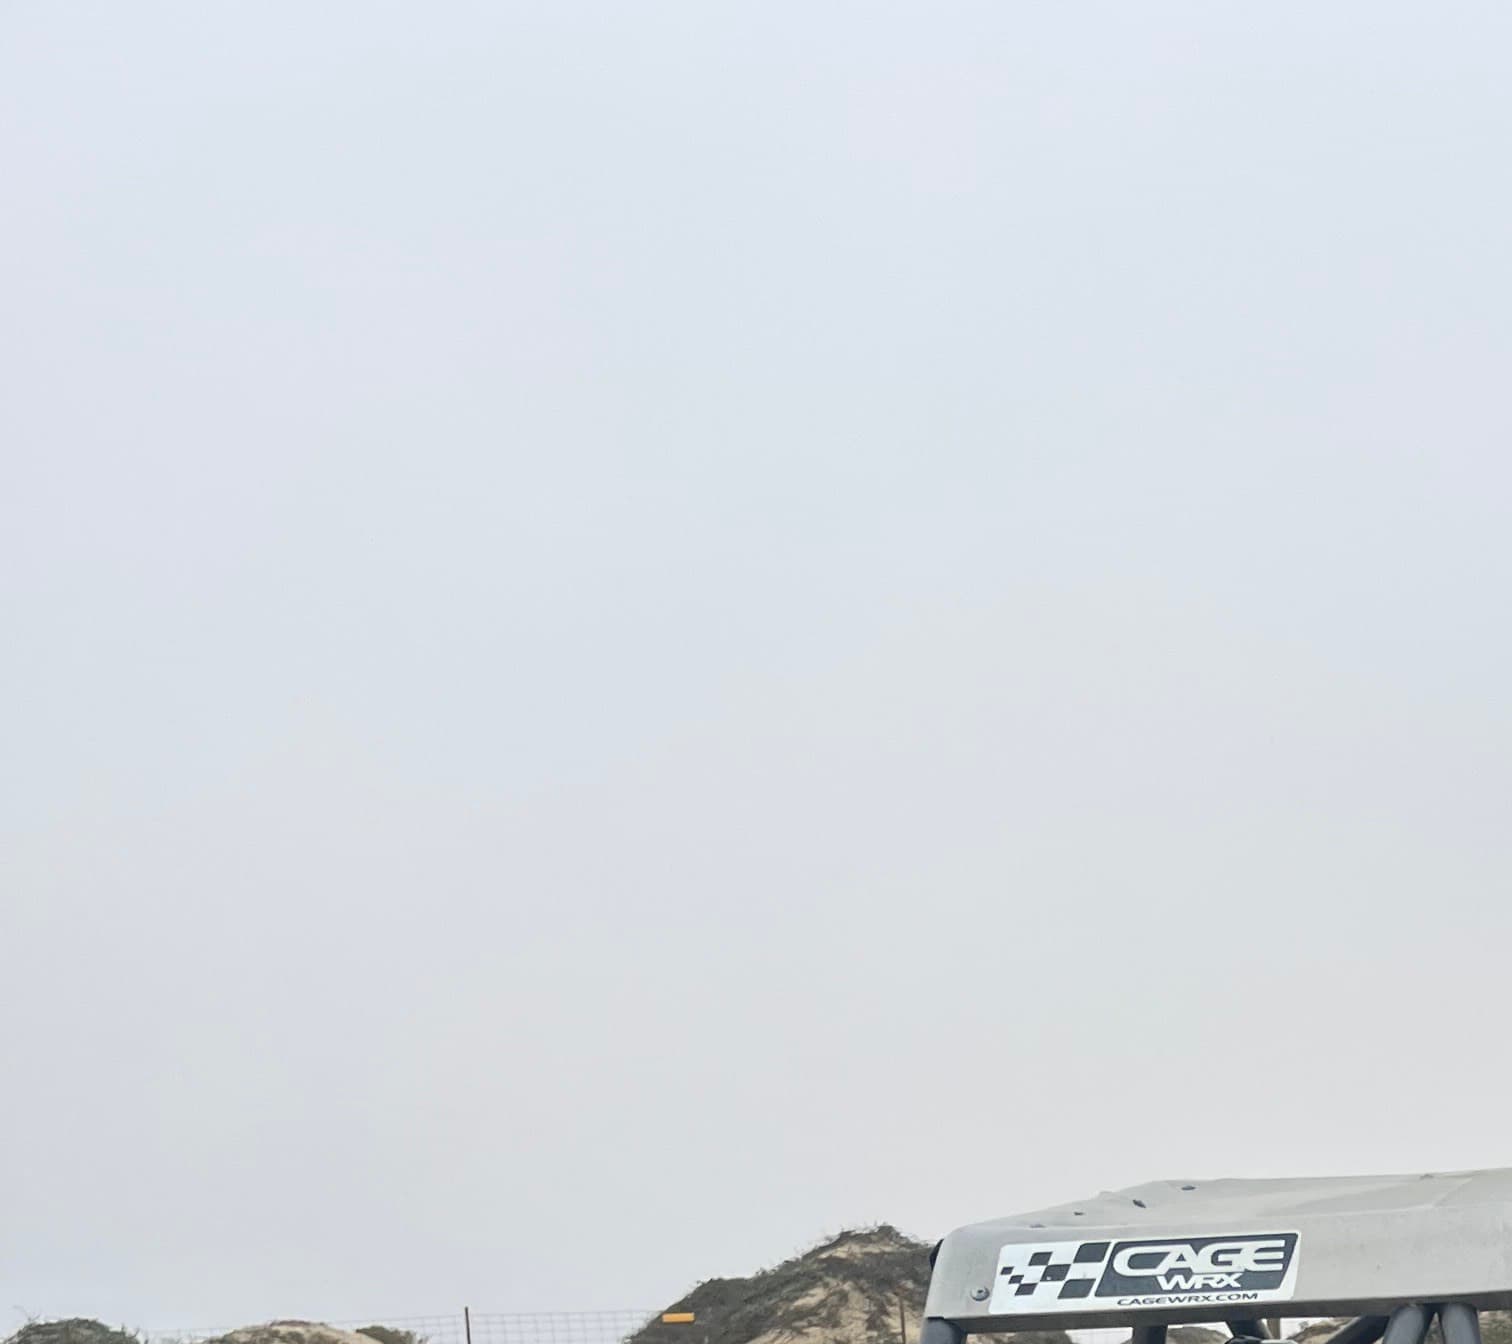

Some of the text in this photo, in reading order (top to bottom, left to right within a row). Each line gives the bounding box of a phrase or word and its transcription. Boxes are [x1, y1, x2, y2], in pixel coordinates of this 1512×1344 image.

[1112, 1239, 1286, 1277] CAGE
[1155, 1272, 1244, 1291] WRX
[1116, 1292, 1259, 1307] CAGEWRX.COM
